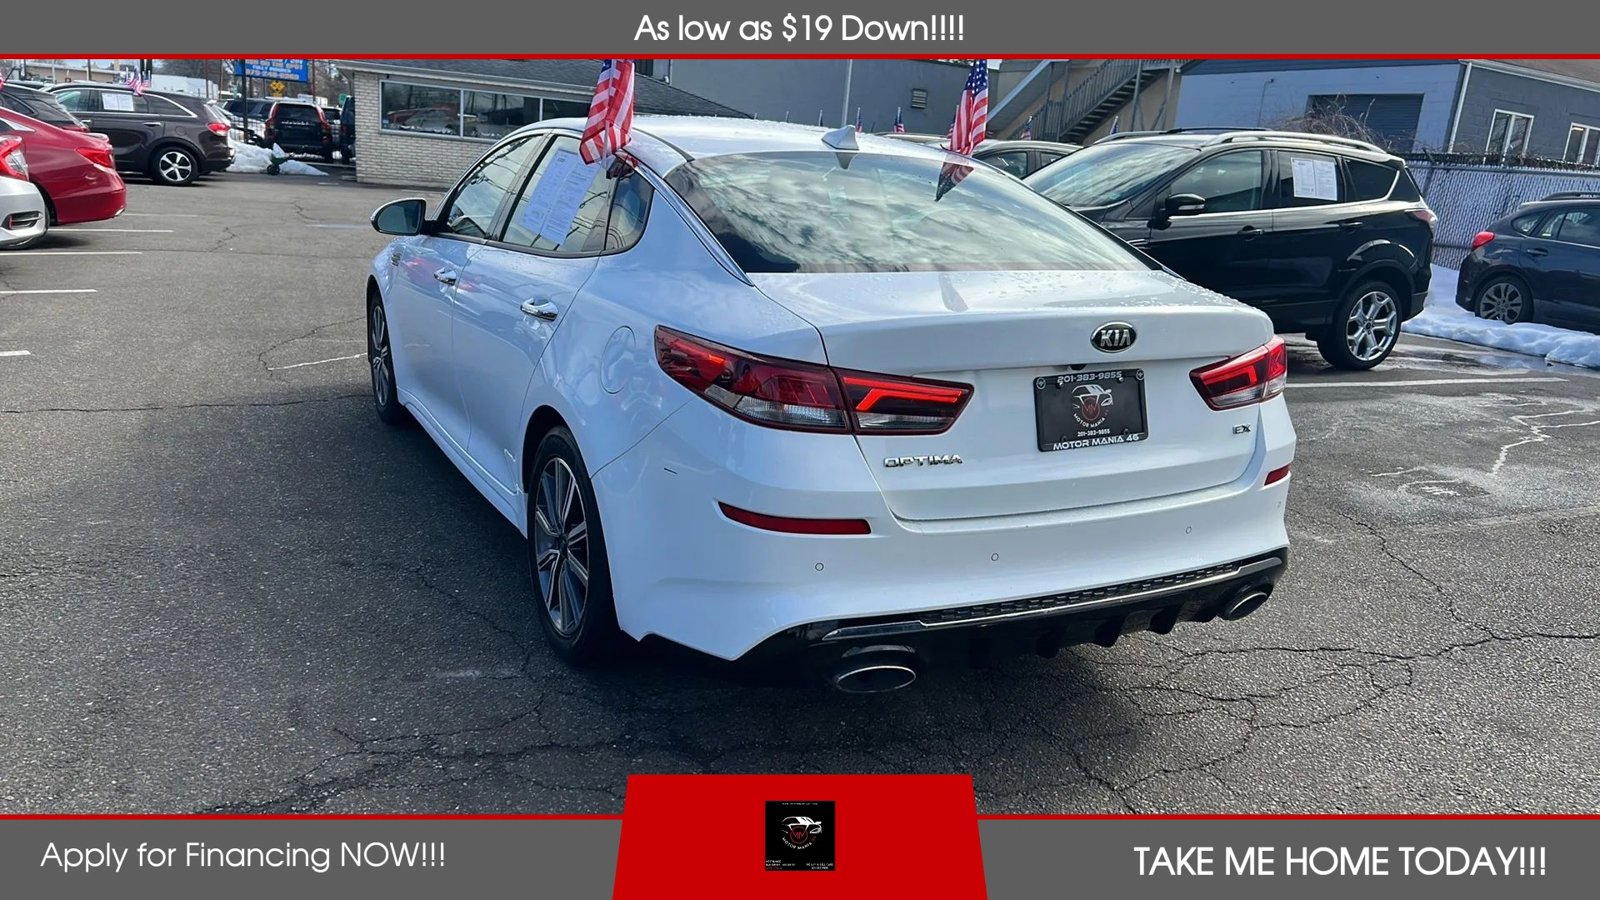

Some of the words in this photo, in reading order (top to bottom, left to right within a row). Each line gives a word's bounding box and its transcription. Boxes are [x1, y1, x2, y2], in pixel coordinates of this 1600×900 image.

[1100, 329, 1131, 347] KIA
[1057, 371, 1123, 383] 201-383-9855
[1073, 413, 1089, 428] MOTOR
[1090, 417, 1106, 428] MANIA
[1232, 423, 1252, 435] EX
[1053, 438, 1090, 451] MOTOR
[1091, 435, 1125, 447] MANIA
[1126, 433, 1140, 442] 46
[883, 454, 964, 468] OPTIMA
